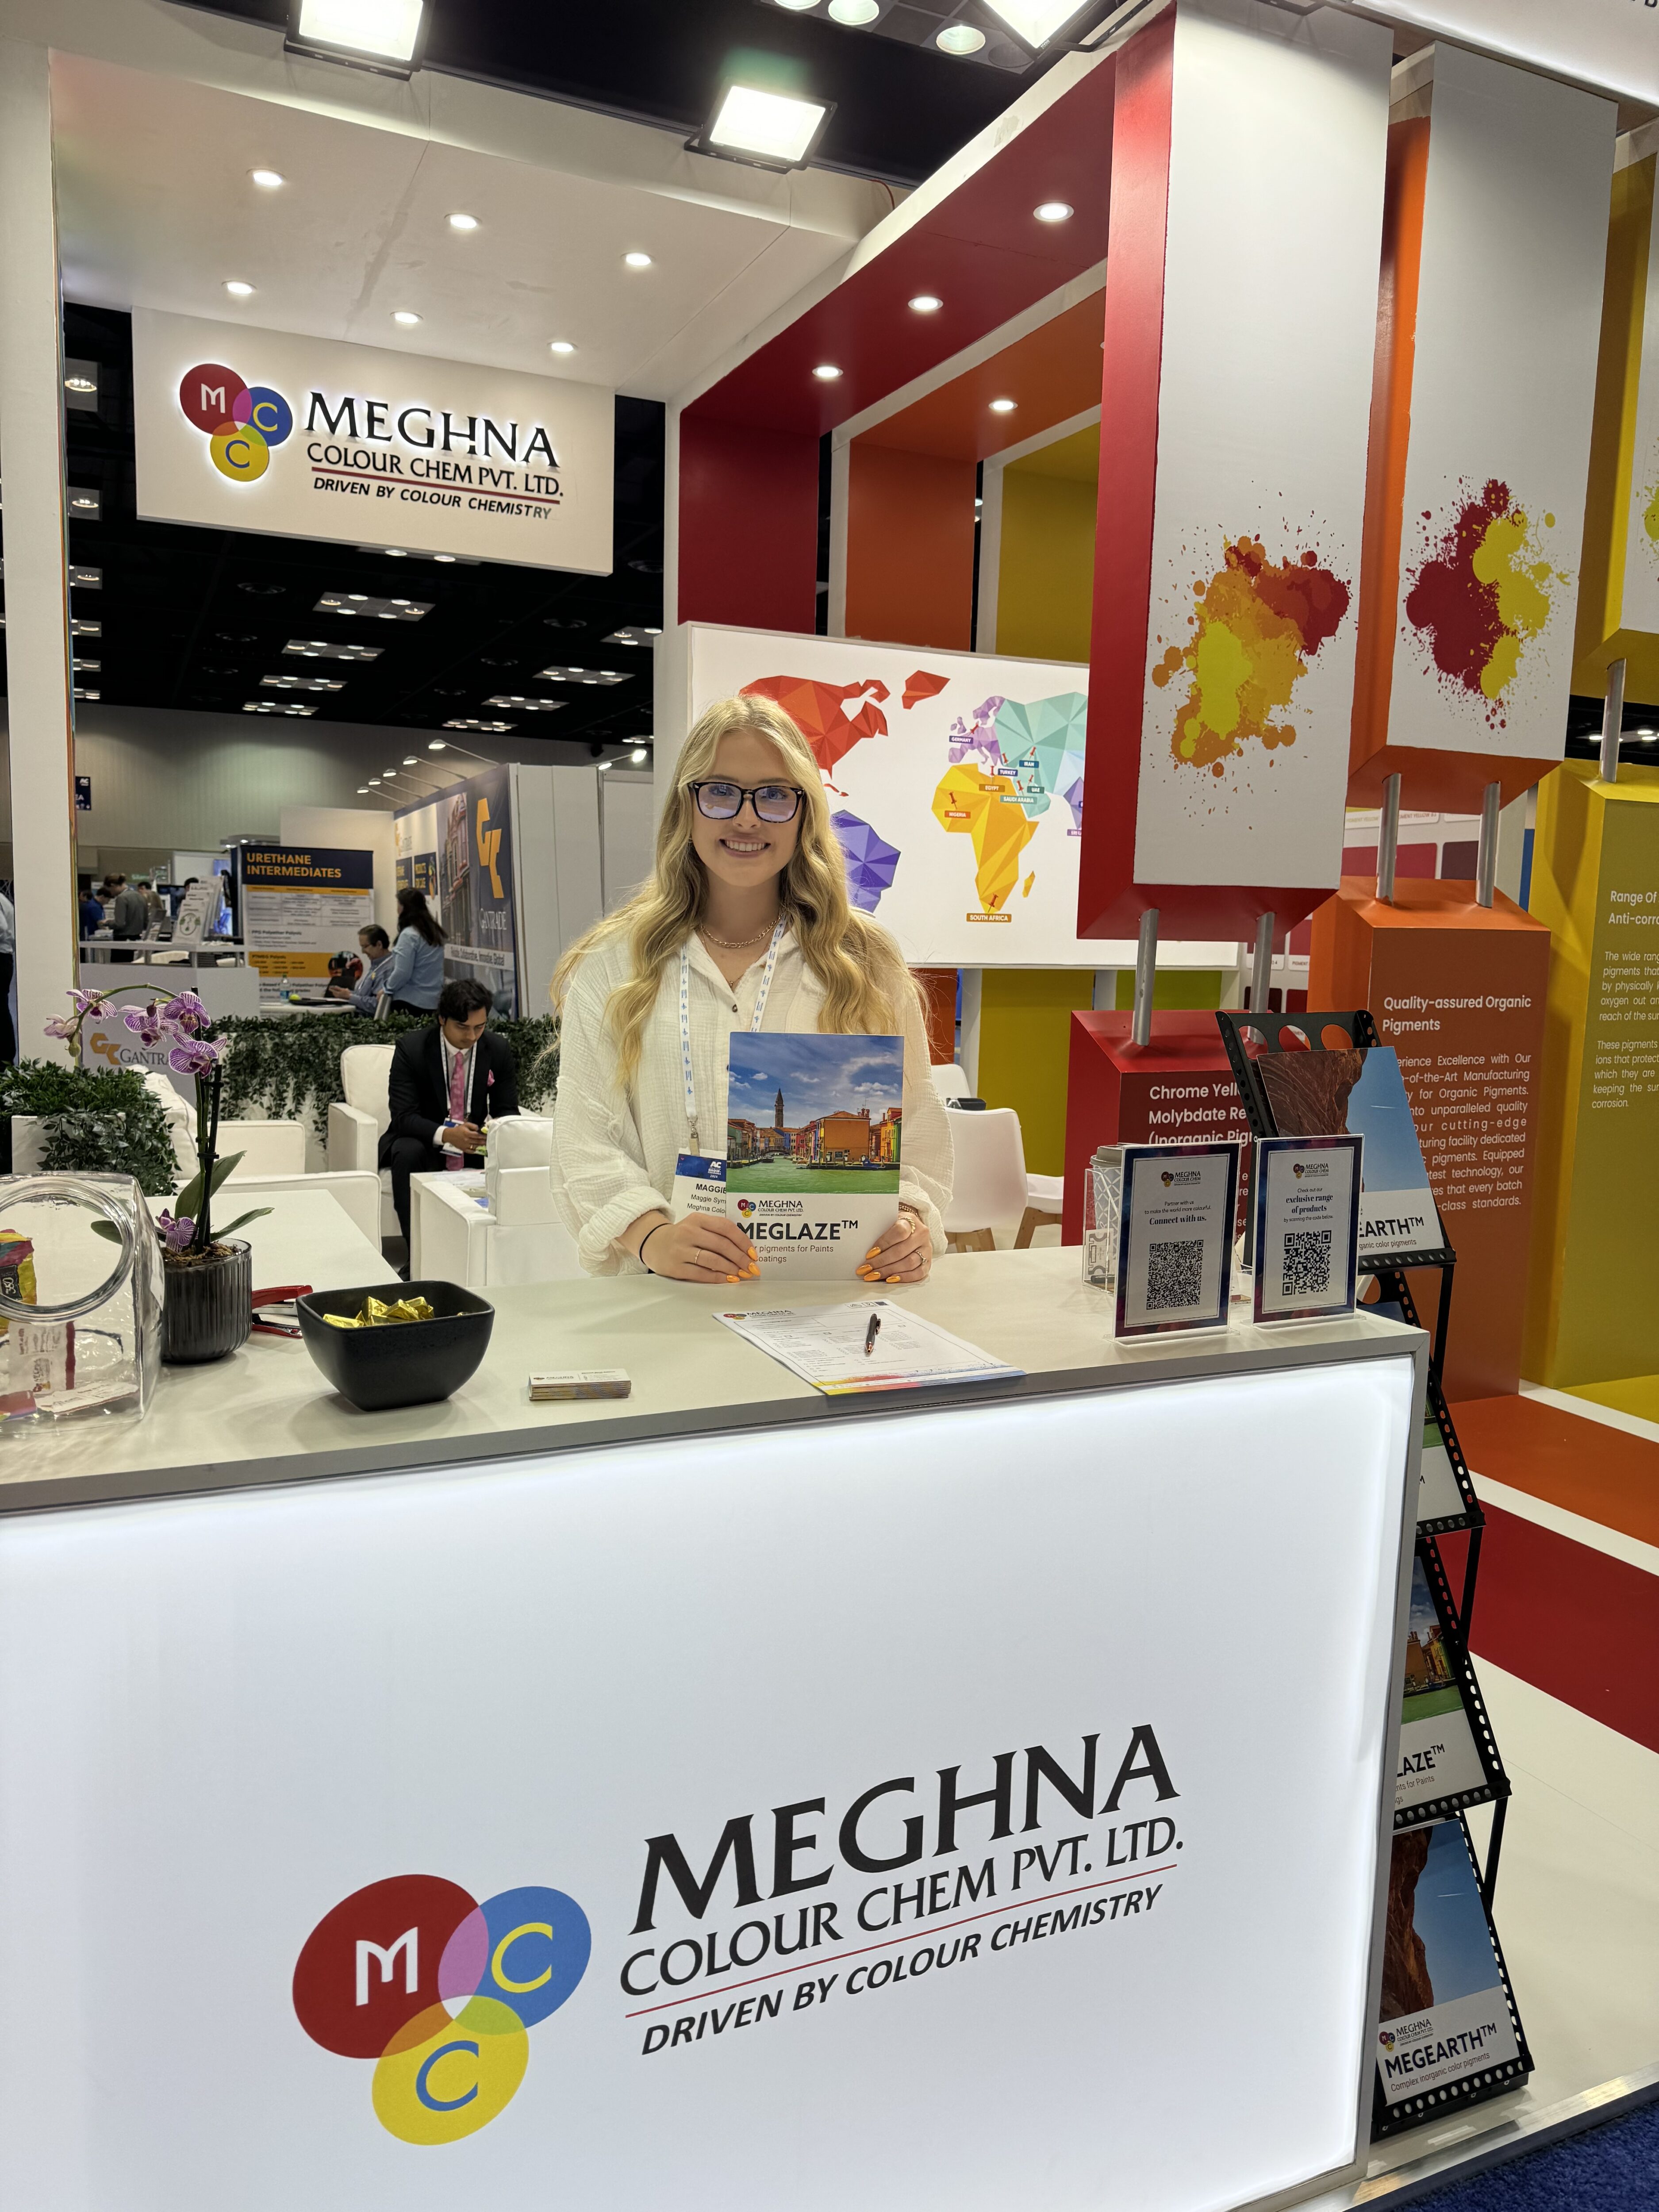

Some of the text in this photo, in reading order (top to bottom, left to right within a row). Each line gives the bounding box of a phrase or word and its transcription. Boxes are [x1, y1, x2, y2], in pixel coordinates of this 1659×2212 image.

[200, 383, 225, 413] M
[253, 403, 278, 432] C
[304, 391, 561, 468] MEGHNA
[226, 440, 250, 469] C
[307, 443, 564, 497] COLOUR CHEM PVT. LTD.
[314, 477, 552, 519] DRIVEN BY COLOUR CHEMISTRY
[247, 853, 311, 864] URETHANE
[247, 865, 342, 878] INTERMEDIATES
[1611, 891, 1657, 906] Range Of
[1605, 951, 1619, 961] The
[1622, 951, 1640, 961] wide
[1603, 966, 1659, 979] pigments that
[1602, 981, 1612, 993] by
[1615, 981, 1653, 993] physically
[1384, 995, 1532, 1013] Quality-assured Organic
[1601, 997, 1628, 1008] oxygen
[1633, 996, 1646, 1005] out
[1599, 1011, 1621, 1021] reach
[1624, 1011, 1632, 1020] of
[1634, 1011, 1646, 1020] the
[1382, 1018, 1440, 1035] Pigments
[1598, 1039, 1658, 1052] These pigments
[1397, 1053, 1531, 1067] erience Excellence with Our
[1596, 1055, 1612, 1064] ions
[1614, 1055, 1630, 1064] that
[1464, 1069, 1529, 1082] Manufacturing
[1594, 1069, 1617, 1079] which
[1622, 1069, 1638, 1080] they
[1150, 1085, 1209, 1100] Chrome
[1420, 1089, 1432, 1099] for
[1439, 1087, 1478, 1101] Organic
[1483, 1086, 1528, 1099] Pigments.
[1594, 1084, 1624, 1096] keeping
[1630, 1083, 1642, 1092] the
[1409, 1101, 1528, 1117] nto unparalleled quality
[1592, 1098, 1628, 1108] corrosion.
[1149, 1107, 1247, 1127] Molybdate Re
[1441, 1118, 1527, 1131] cutting-edge
[1419, 1132, 1525, 1150] turing facility dedicated
[1432, 1152, 1478, 1167] pigments.
[1483, 1148, 1525, 1163] Equipped
[1452, 1167, 1503, 1178] technology,
[1509, 1165, 1524, 1174] our
[696, 1183, 726, 1194] MAGGIE
[1447, 1184, 1465, 1194] that
[1469, 1183, 1494, 1194] every
[1497, 1180, 1522, 1191] batch
[1286, 1194, 1333, 1203] exclusive range
[1472, 1196, 1521, 1208] standards.
[687, 1203, 710, 1212] Meghna
[1299, 1205, 1327, 1214] products
[1149, 1216, 1178, 1225] Connect
[1359, 1242, 1375, 1250] ganic
[1391, 1240, 1417, 1248] pigments
[1416, 1776, 1435, 1786] Paints
[627, 1724, 1180, 1935] MEGHNA
[621, 1816, 1185, 1996] COLOUR CHEM PVT. LTD.
[491, 1921, 553, 1993] C
[355, 1926, 418, 2006] M
[641, 1884, 1163, 2056] DRIVEN BY COLOUR CHEMISTRY
[1396, 2019, 1432, 2036] MEGHNA
[415, 2040, 479, 2112] C
[1391, 2052, 1490, 2092] Complex inorganic color pigments
